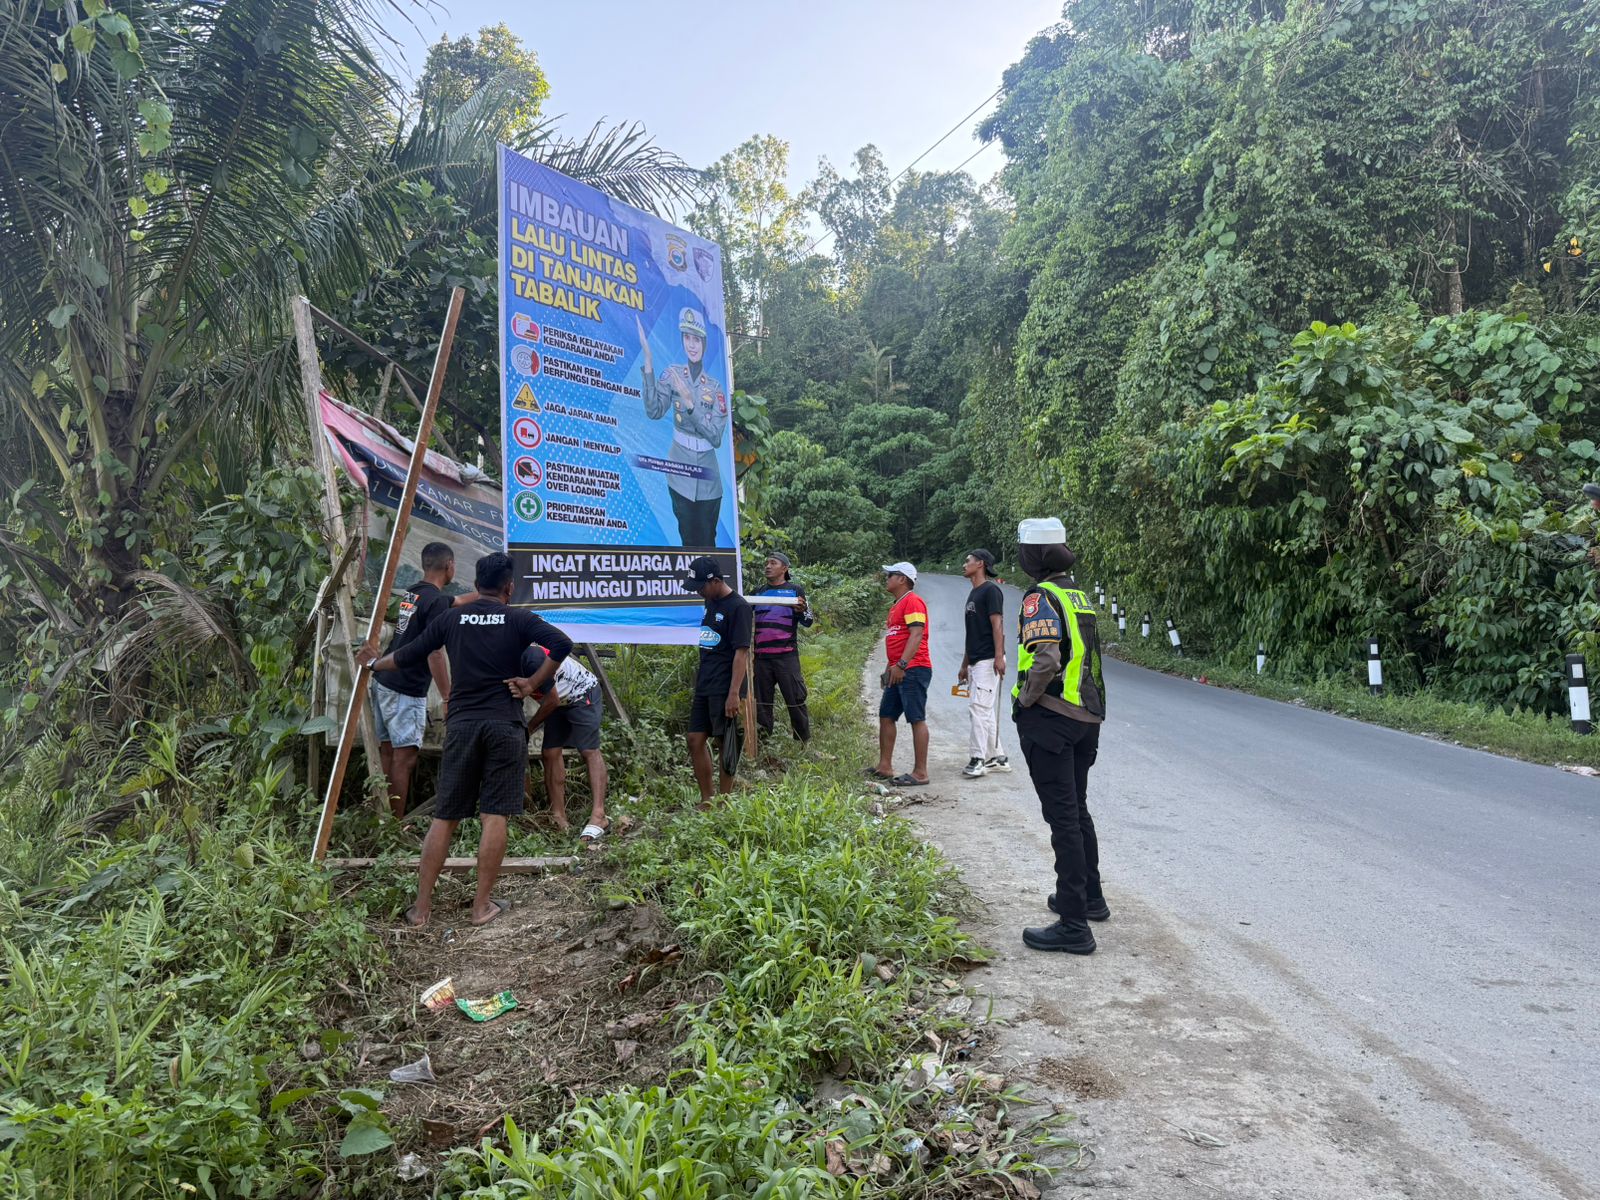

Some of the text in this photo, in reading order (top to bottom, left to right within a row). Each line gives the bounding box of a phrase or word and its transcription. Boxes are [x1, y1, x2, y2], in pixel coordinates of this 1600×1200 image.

[510, 181, 628, 256] IMBAUAN
[511, 217, 638, 284] LALU LINTAS
[511, 244, 643, 311] DI TANJAKAN
[511, 272, 602, 322] TABALIK
[543, 326, 623, 356] PERIKSA KELAYAKAN
[543, 336, 616, 363] KENDARAAN ANDA
[543, 356, 601, 378] PASTIKAN REM
[543, 367, 641, 398] BERFUNGSI DENGAN BAIK
[544, 403, 617, 426] JAGA JARAK AMAN
[545, 433, 621, 454] JANGAN MENYALIP
[546, 462, 620, 481] PASTIKAN MUATAN
[546, 472, 620, 490] KENDARAAN TIDAK
[546, 481, 606, 498] OVER LOADING
[547, 502, 606, 517] PRIORITASKAN
[547, 512, 605, 526] KESELAMATAN
[606, 519, 628, 529] ANDA
[461, 520, 504, 547] KOSO
[532, 554, 703, 573] INGAT KELUARGA AN
[533, 579, 698, 600] MENUNGGU DIRUM
[459, 614, 506, 625] POLISI
